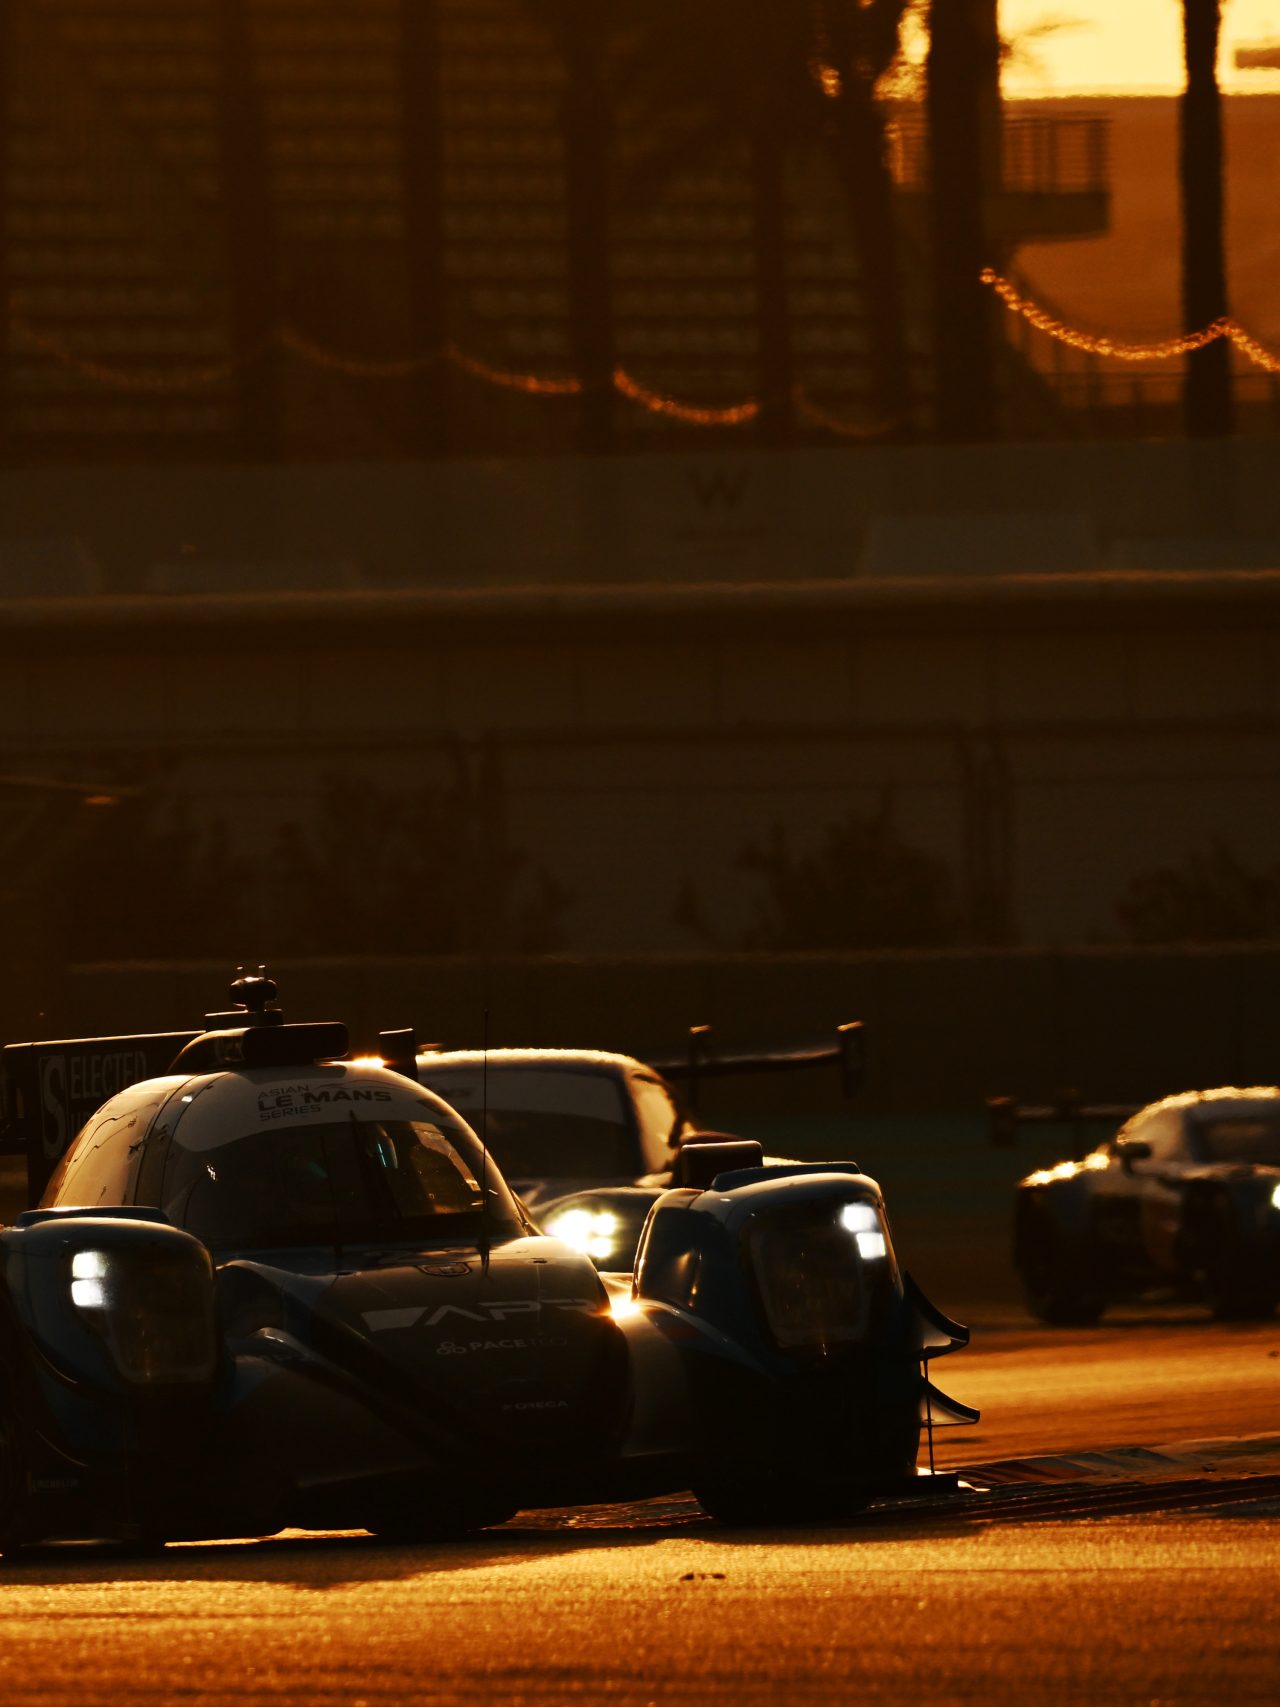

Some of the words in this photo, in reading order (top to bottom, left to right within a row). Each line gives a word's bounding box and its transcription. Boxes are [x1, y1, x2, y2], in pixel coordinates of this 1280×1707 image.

[257, 1084, 310, 1099] ASIAN
[258, 1094, 292, 1112] LE
[303, 1090, 393, 1103] MANS
[259, 1105, 321, 1121] SERIES
[469, 1338, 528, 1351] PACE
